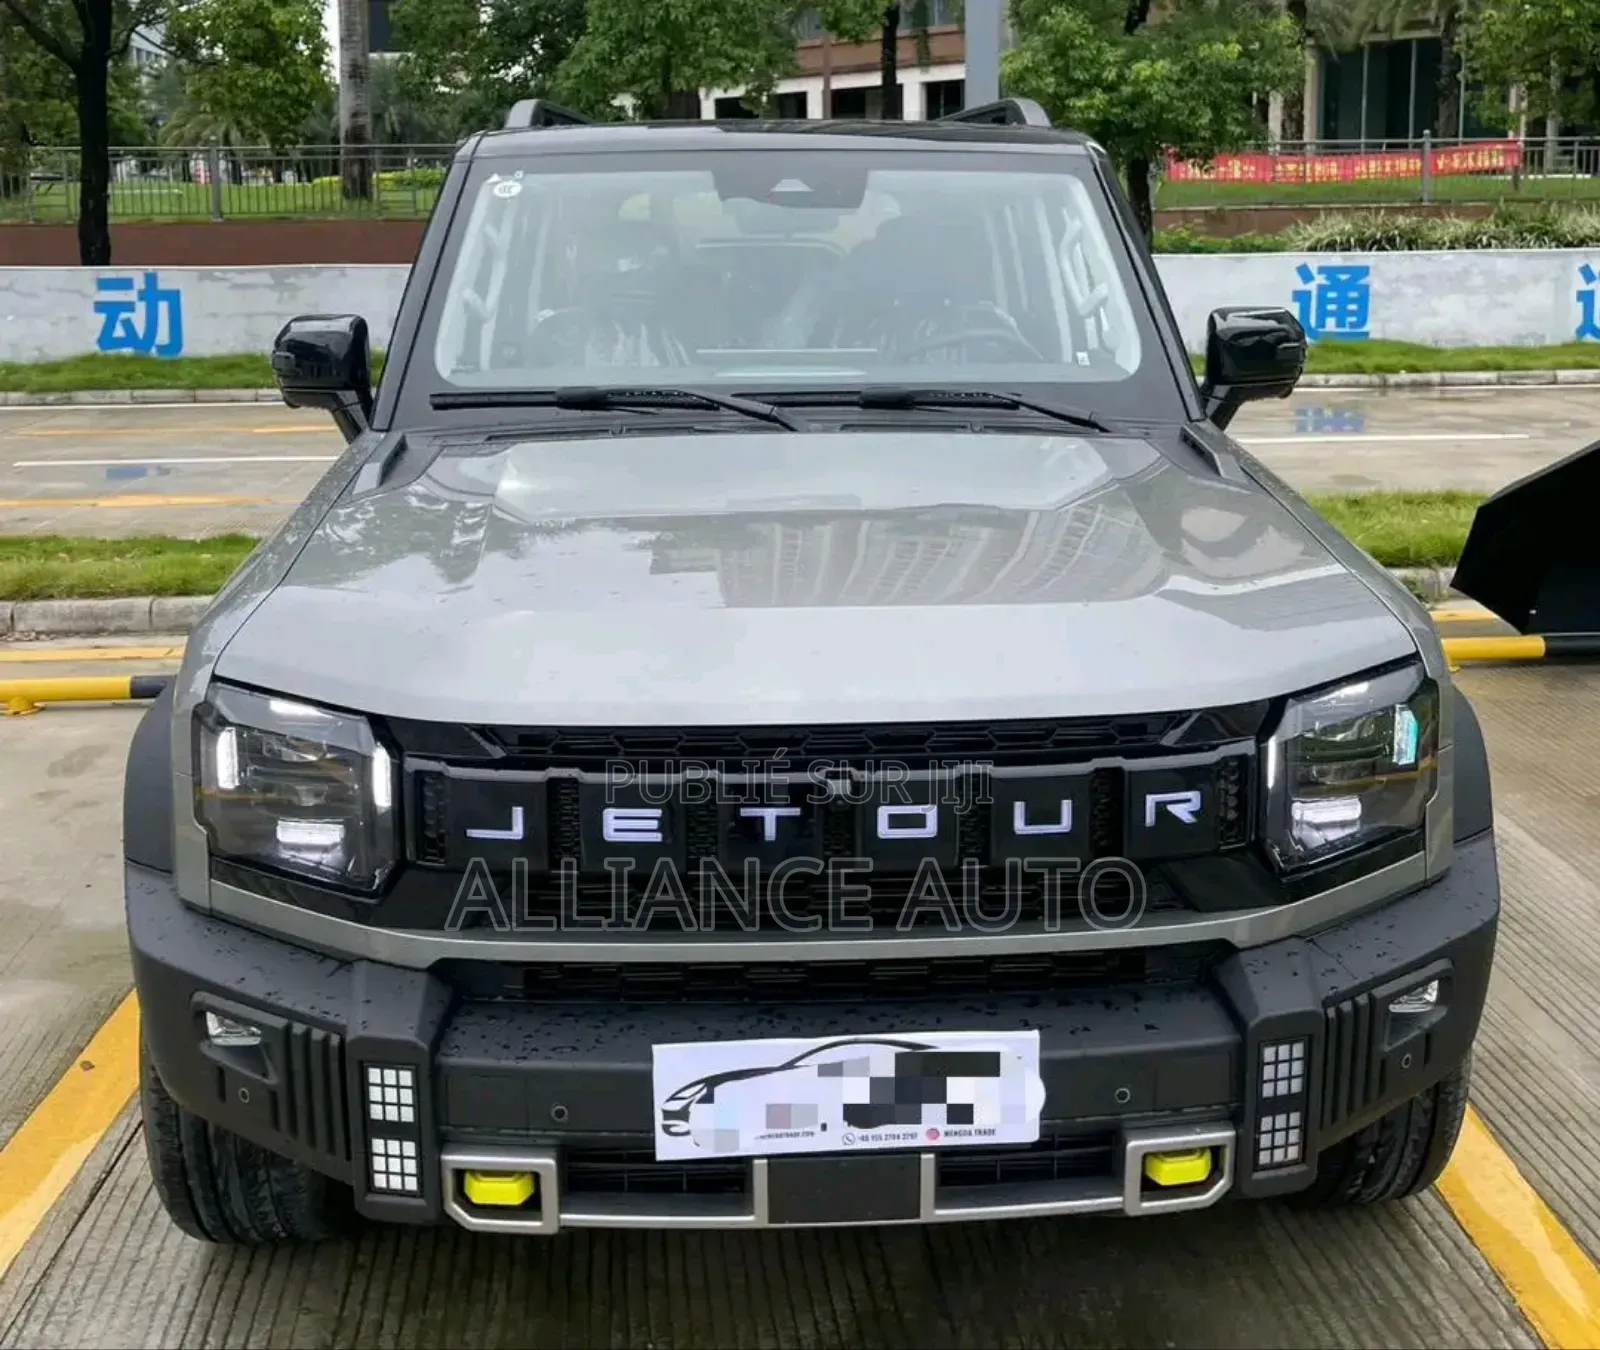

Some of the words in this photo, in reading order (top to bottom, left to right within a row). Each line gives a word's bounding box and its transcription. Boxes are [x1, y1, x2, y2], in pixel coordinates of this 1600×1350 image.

[93, 271, 183, 358] 动
[1292, 263, 1370, 341] 通
[465, 790, 1202, 842] JETOUR
[974, 1128, 997, 1137] TRADE
